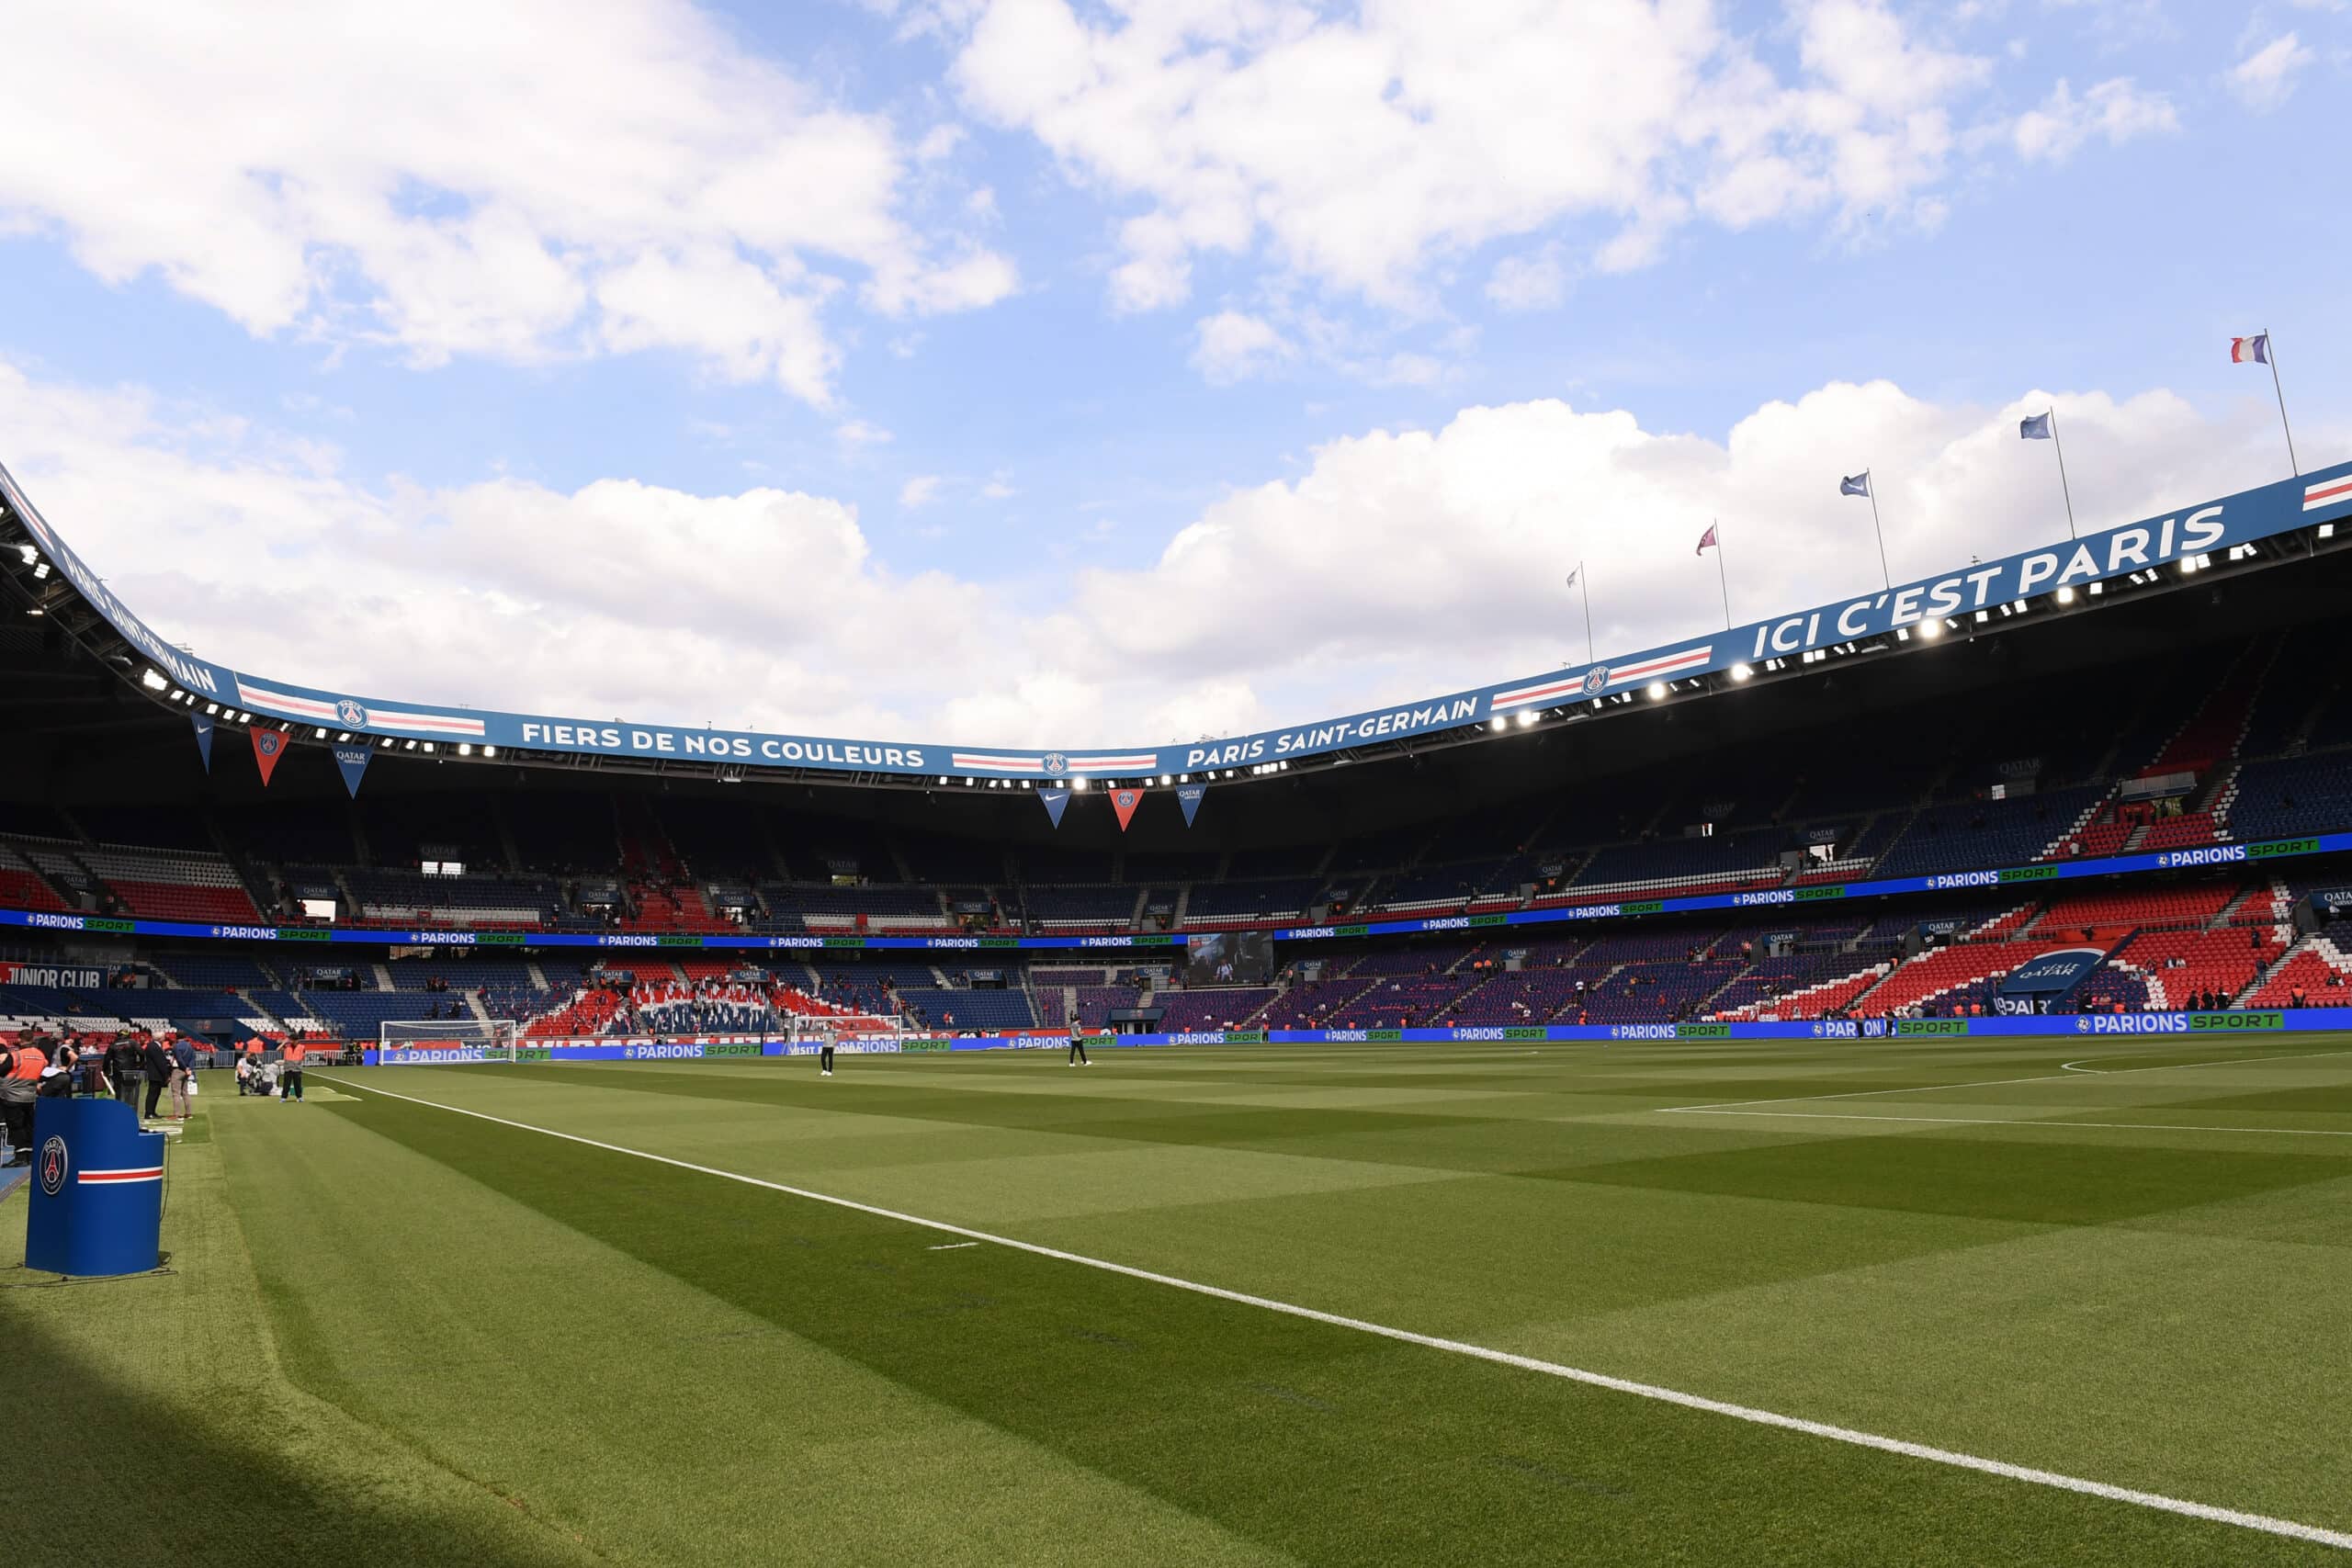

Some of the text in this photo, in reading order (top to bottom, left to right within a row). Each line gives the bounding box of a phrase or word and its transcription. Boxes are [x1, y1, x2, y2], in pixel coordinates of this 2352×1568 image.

[62, 548, 107, 610] PARIS
[1752, 503, 2226, 658] ICI C'EST PARIS
[1187, 697, 1478, 767] PARIS SAINT-GERMAIN
[522, 722, 925, 768] FIERS DE NOS COULEURS
[336, 750, 366, 761] QATAR
[1810, 829, 1836, 839] QATAR
[2172, 840, 2316, 866] PARIONS SPORT
[1938, 867, 2056, 888] PARIONS SPORT
[303, 886, 328, 895] QATAR
[1742, 887, 1843, 905] PARIONS SPORT
[1576, 903, 1662, 918] PARIONS SPORT
[37, 914, 134, 931] PARIONS SPORT
[1430, 916, 1505, 929] PARIONS SPORT
[1928, 921, 1954, 932] QATAR
[222, 927, 330, 939] PARIONS SPORT
[421, 932, 475, 943] PARIONS
[1295, 927, 1368, 938] PARIONS SPORT
[1770, 933, 1793, 942] QATAR
[607, 936, 657, 946] PARIONS
[778, 937, 823, 947] PARIONS
[935, 937, 978, 947] PARIONS
[1089, 937, 1132, 947] PARIONS
[1508, 948, 1527, 957] QATAR
[316, 968, 341, 976] QATAR
[601, 970, 623, 978] QATAR
[2018, 969, 2075, 979] QATAR
[6, 967, 100, 989] JUNIOR CLUB
[1826, 1021, 1964, 1036] PARON SPORT
[2094, 1014, 2279, 1032] PARIONS SPORT
[1331, 1030, 1401, 1041] PARIONS SPORT
[1460, 1028, 1545, 1040] PARIONS SPORT
[1621, 1025, 1727, 1038] PARIONS SPORT
[1018, 1037, 1114, 1048] PARIONS PORT
[1177, 1032, 1260, 1043] PARIONS SPOR
[901, 1041, 949, 1050] SPORT
[409, 1049, 482, 1061] PARIONS
[638, 1045, 759, 1058] PARIONS SPORT
